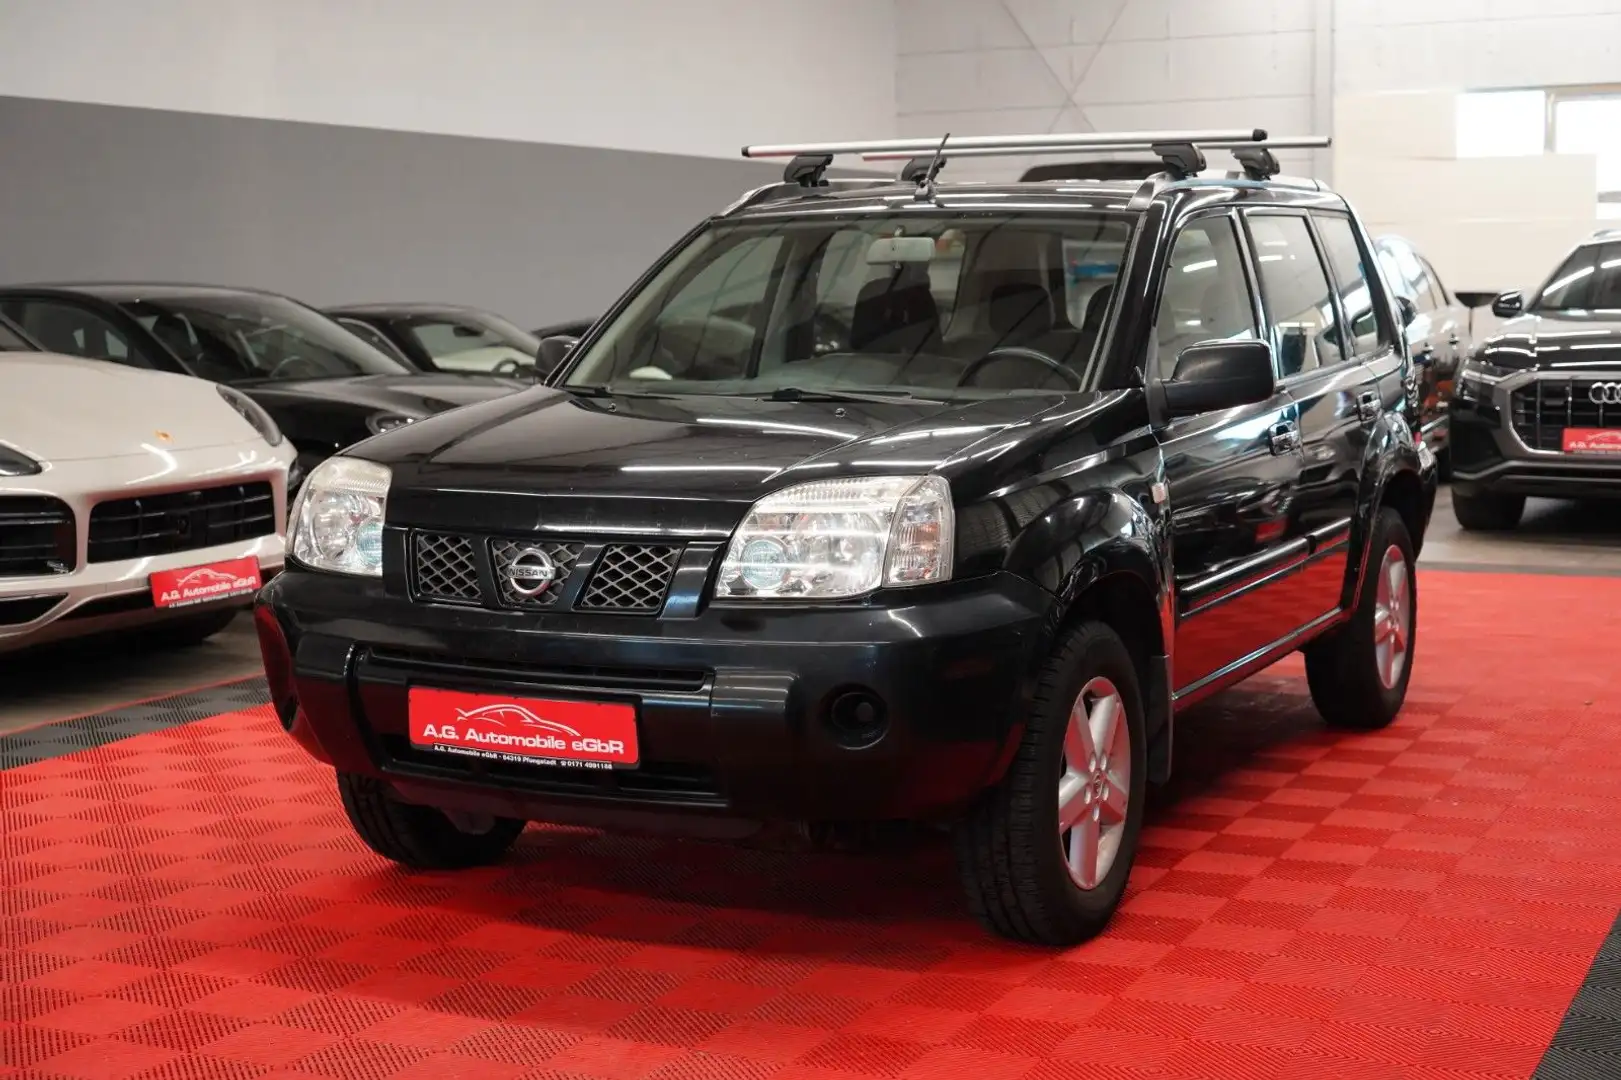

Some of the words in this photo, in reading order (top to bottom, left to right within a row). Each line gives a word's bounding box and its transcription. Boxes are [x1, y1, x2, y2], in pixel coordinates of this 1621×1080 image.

[508, 568, 548, 577] NISSAN
[423, 724, 459, 740] A.G.
[464, 728, 566, 750] Automobile
[571, 738, 624, 755] eGbR
[447, 747, 480, 757] Automobile
